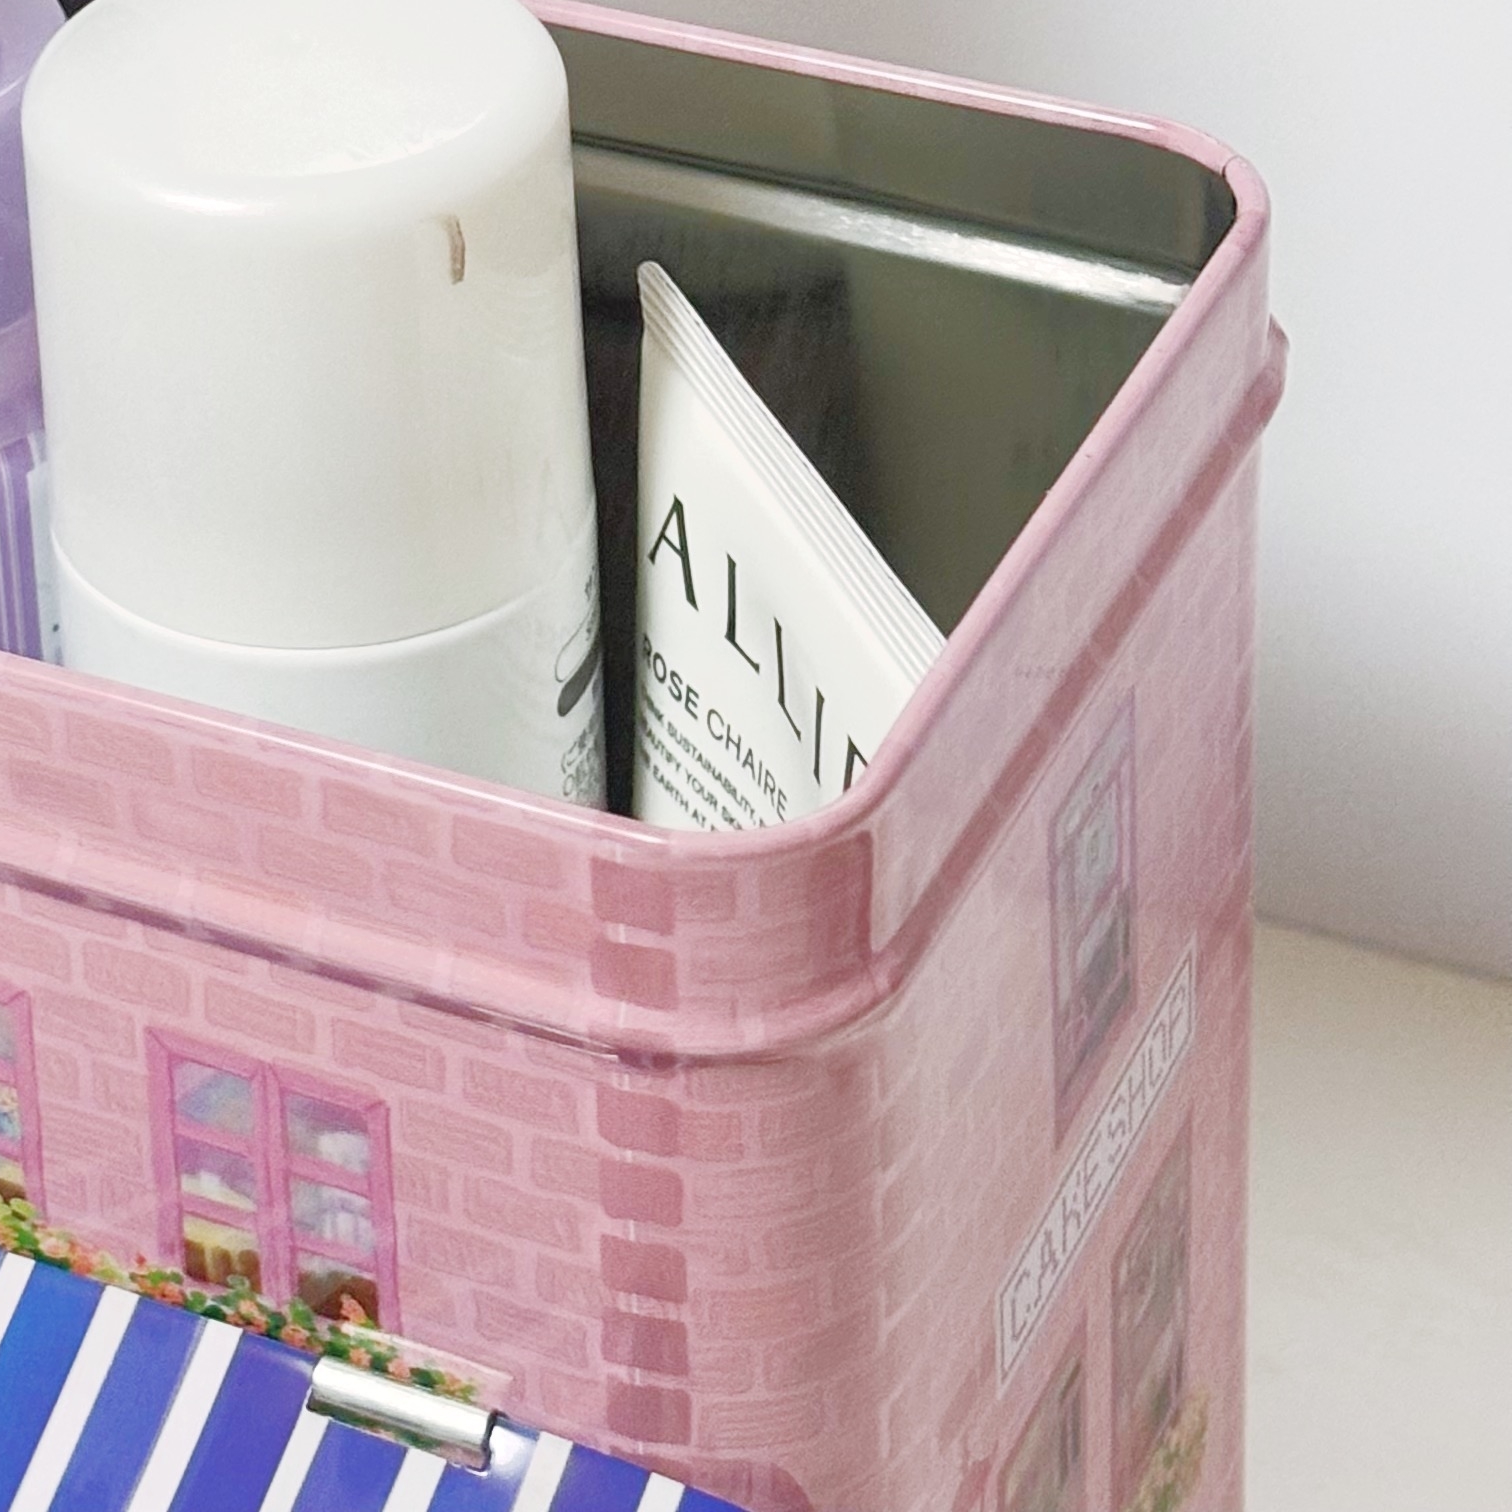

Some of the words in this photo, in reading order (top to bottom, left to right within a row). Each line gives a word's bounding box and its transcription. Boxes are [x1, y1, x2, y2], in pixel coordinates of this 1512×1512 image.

[643, 633, 699, 720] ROSE
[707, 708, 788, 823] CHAIRE
[685, 768, 719, 812] YOUR
[652, 764, 689, 813] EARTH
[692, 808, 707, 829] AT
[1011, 1130, 1102, 1342] CAKE
[1107, 986, 1185, 1166] SHOP
